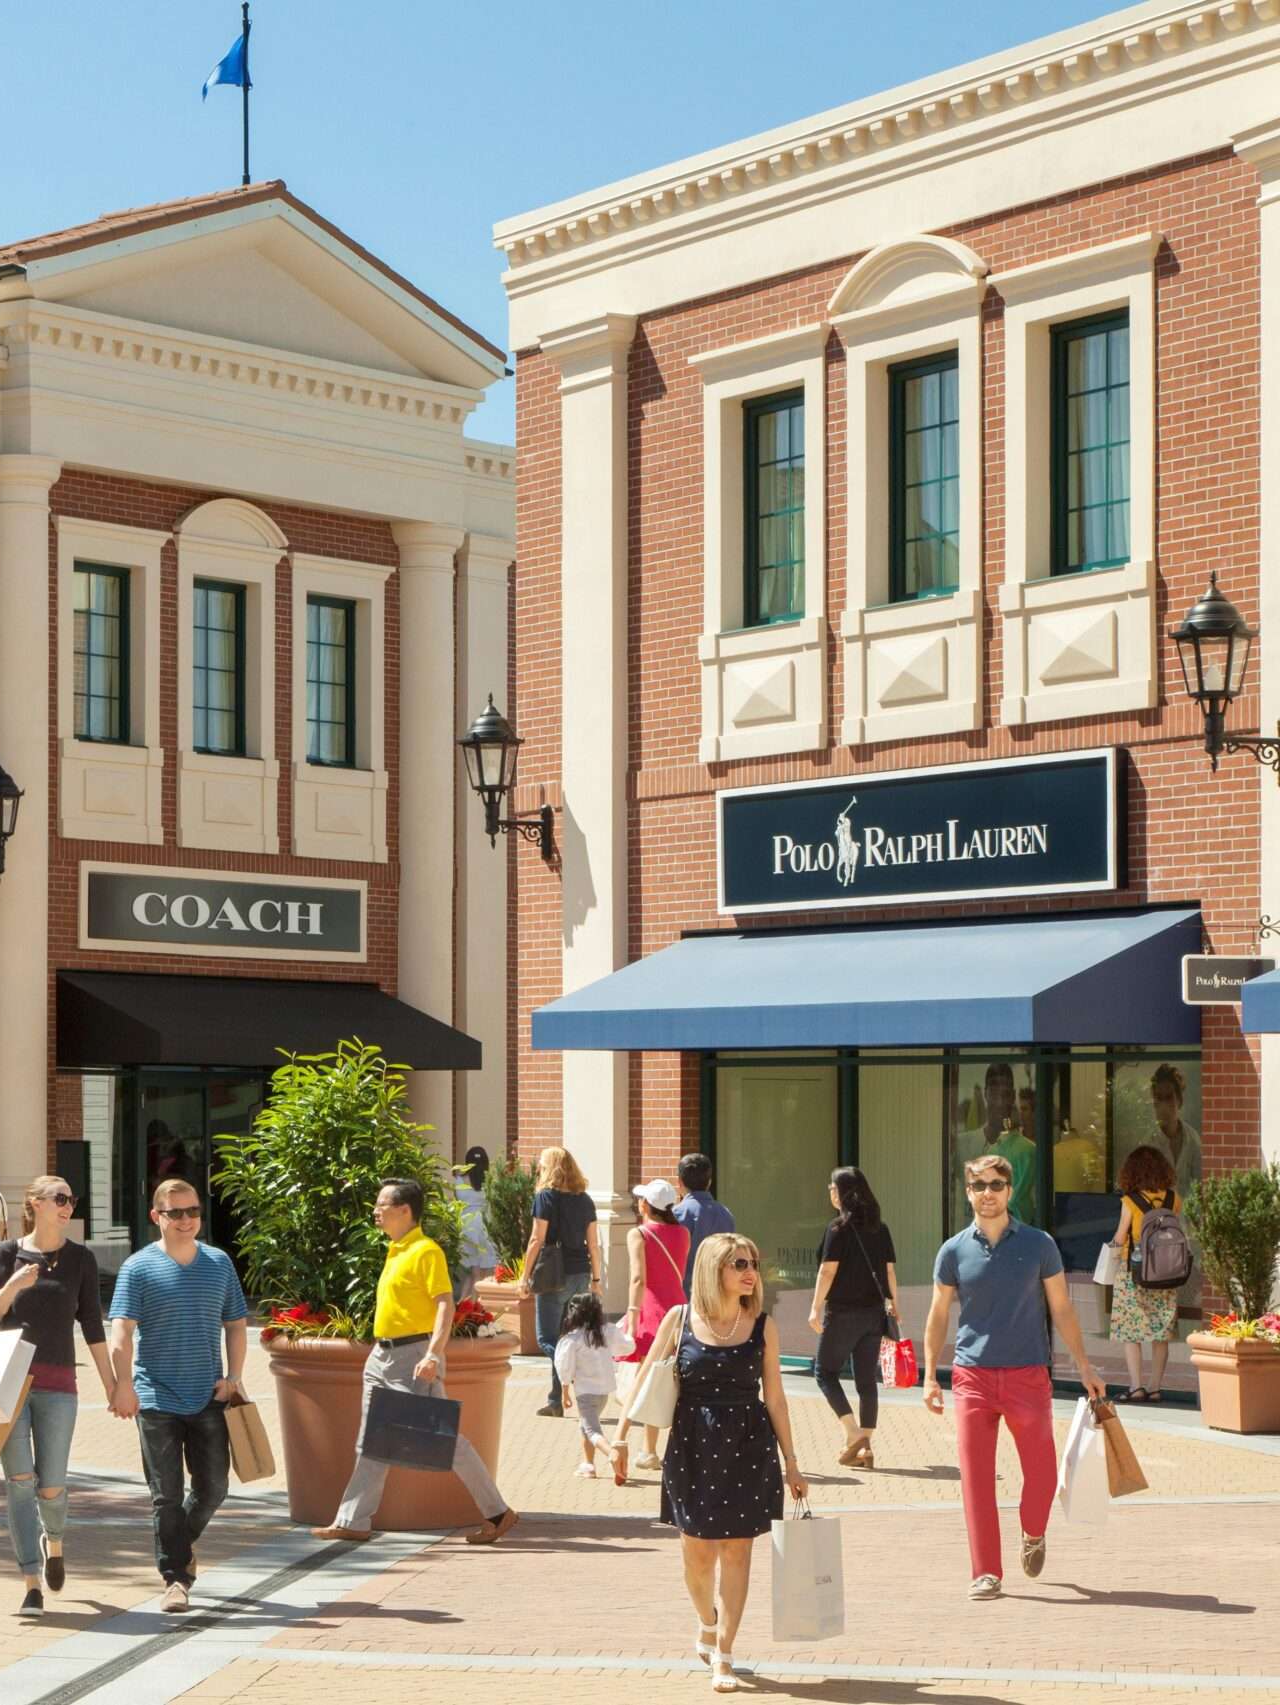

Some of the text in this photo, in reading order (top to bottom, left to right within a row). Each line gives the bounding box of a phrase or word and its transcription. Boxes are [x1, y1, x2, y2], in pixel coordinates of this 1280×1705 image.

[772, 819, 1049, 875] POLO RALPH LAUREN
[131, 891, 324, 935] COACH
